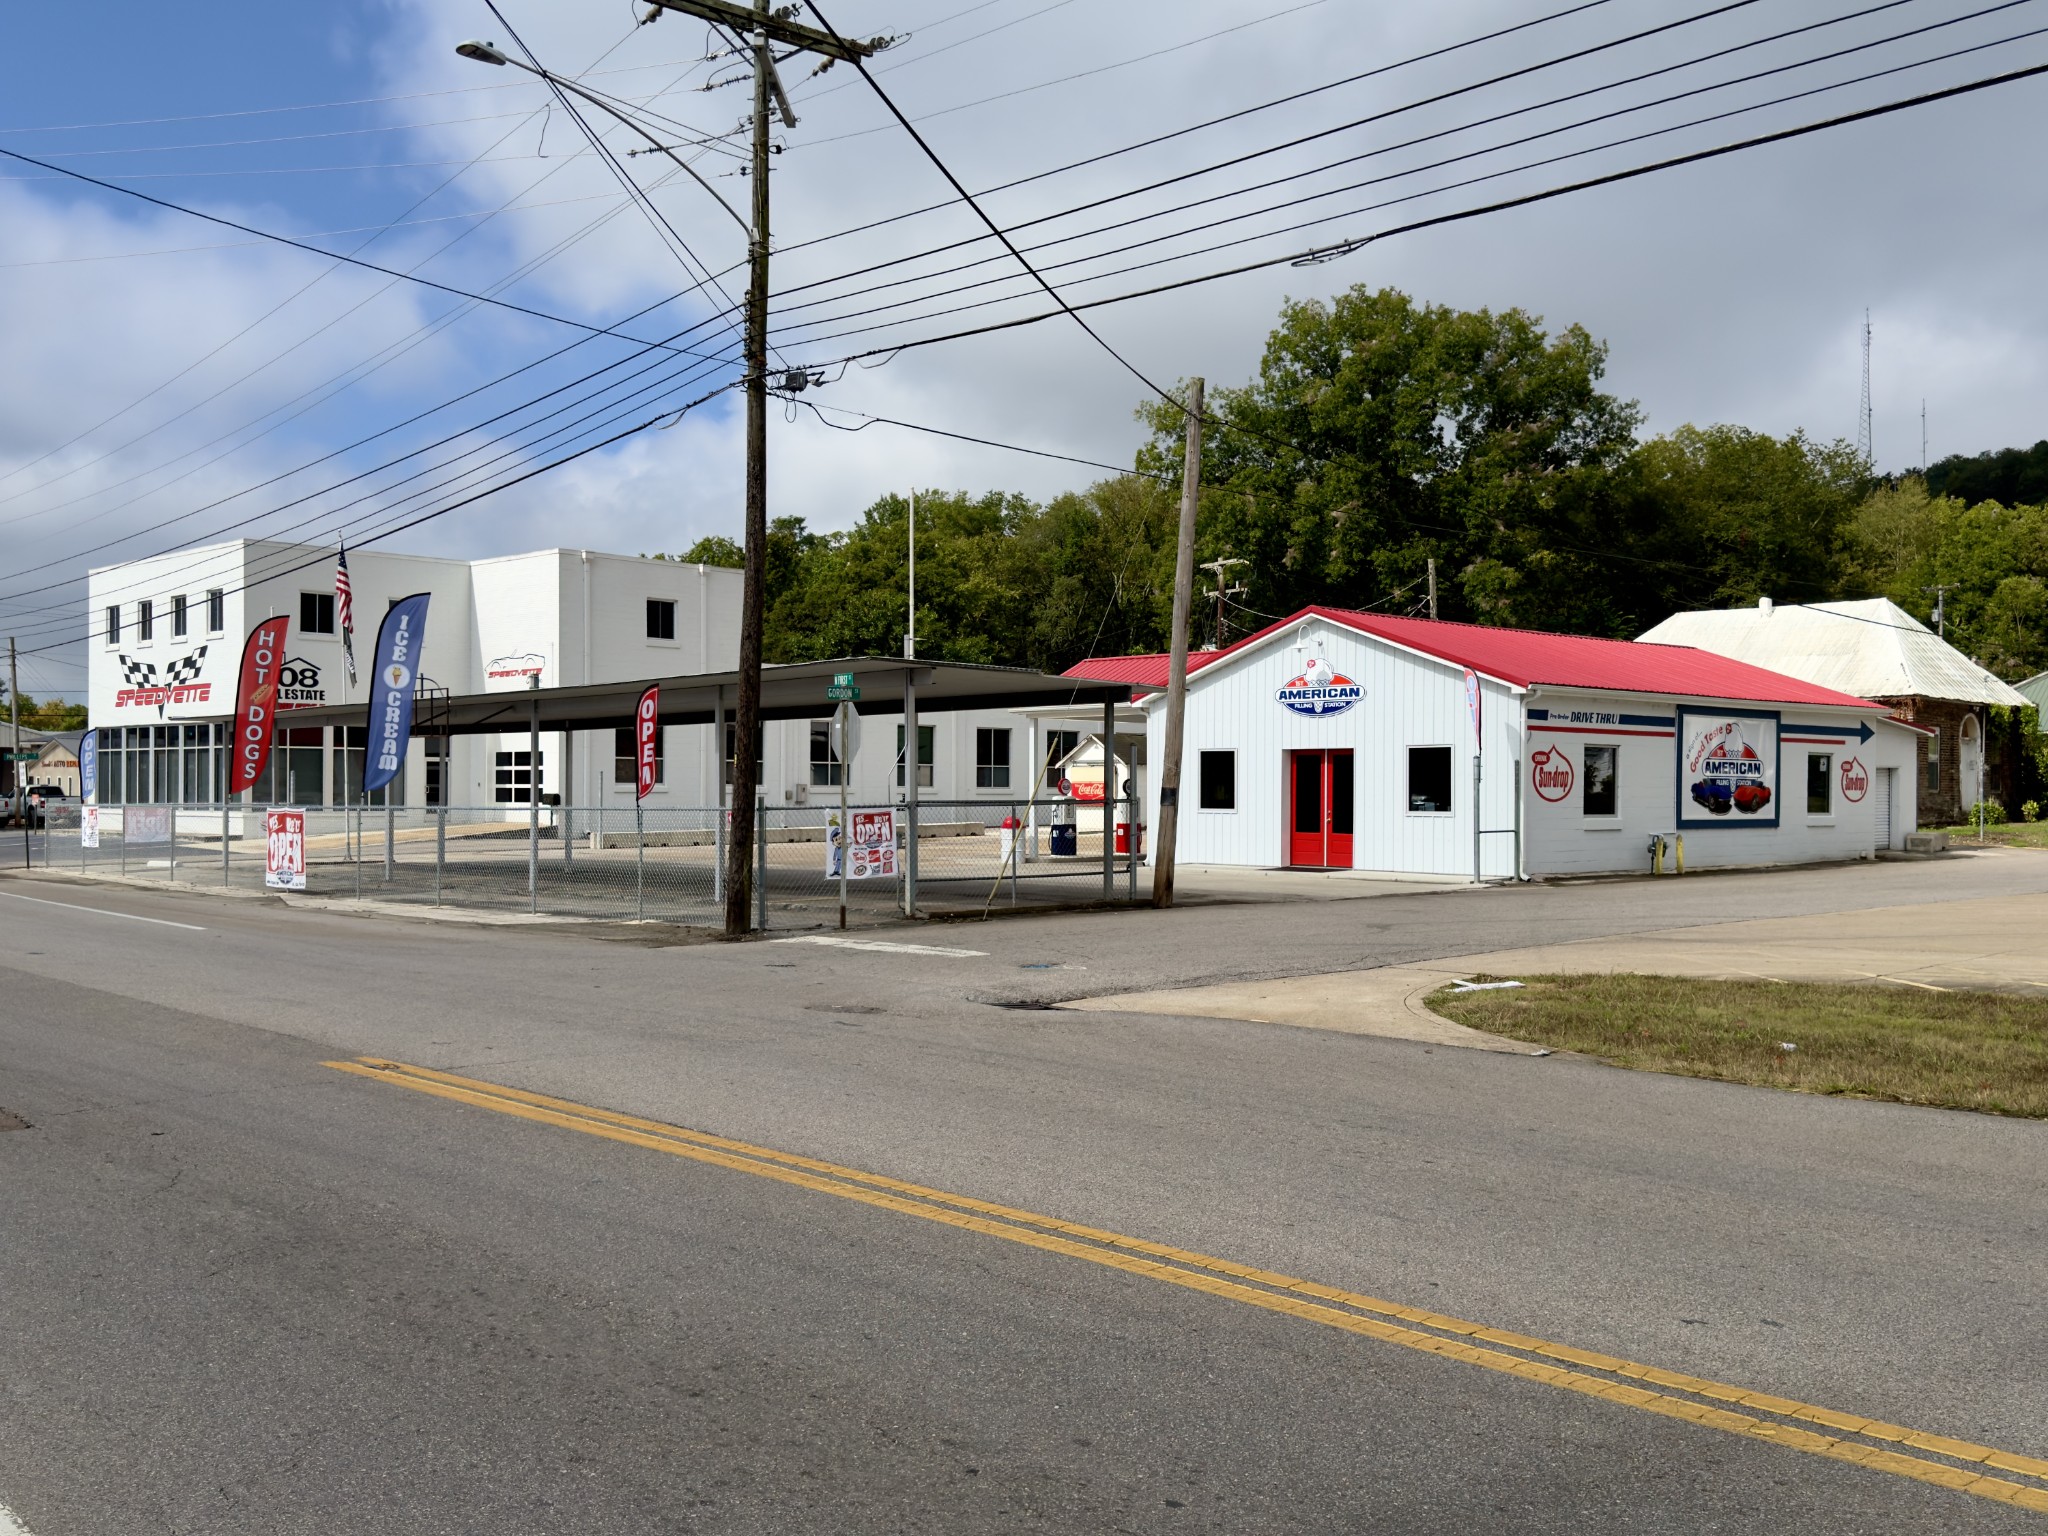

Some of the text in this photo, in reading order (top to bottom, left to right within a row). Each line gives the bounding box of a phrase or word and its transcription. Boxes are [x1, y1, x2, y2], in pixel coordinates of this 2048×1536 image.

[115, 683, 212, 707] SPEEDVETTE
[244, 630, 274, 779] HOT DOGS
[285, 689, 326, 701] ESTATE
[378, 615, 409, 771] ICE CREAM
[828, 688, 853, 698] GORDON
[1279, 687, 1360, 700] AMERICAN
[1570, 712, 1595, 723] DRIVE
[1596, 713, 1618, 725] THRU
[641, 699, 655, 785] OPEN
[1690, 726, 1723, 773] Good Taste
[84, 738, 95, 791] OPEN
[1705, 761, 1761, 775] AMERICAN
[856, 822, 891, 843] OPEN
[269, 831, 303, 872] OPEN
